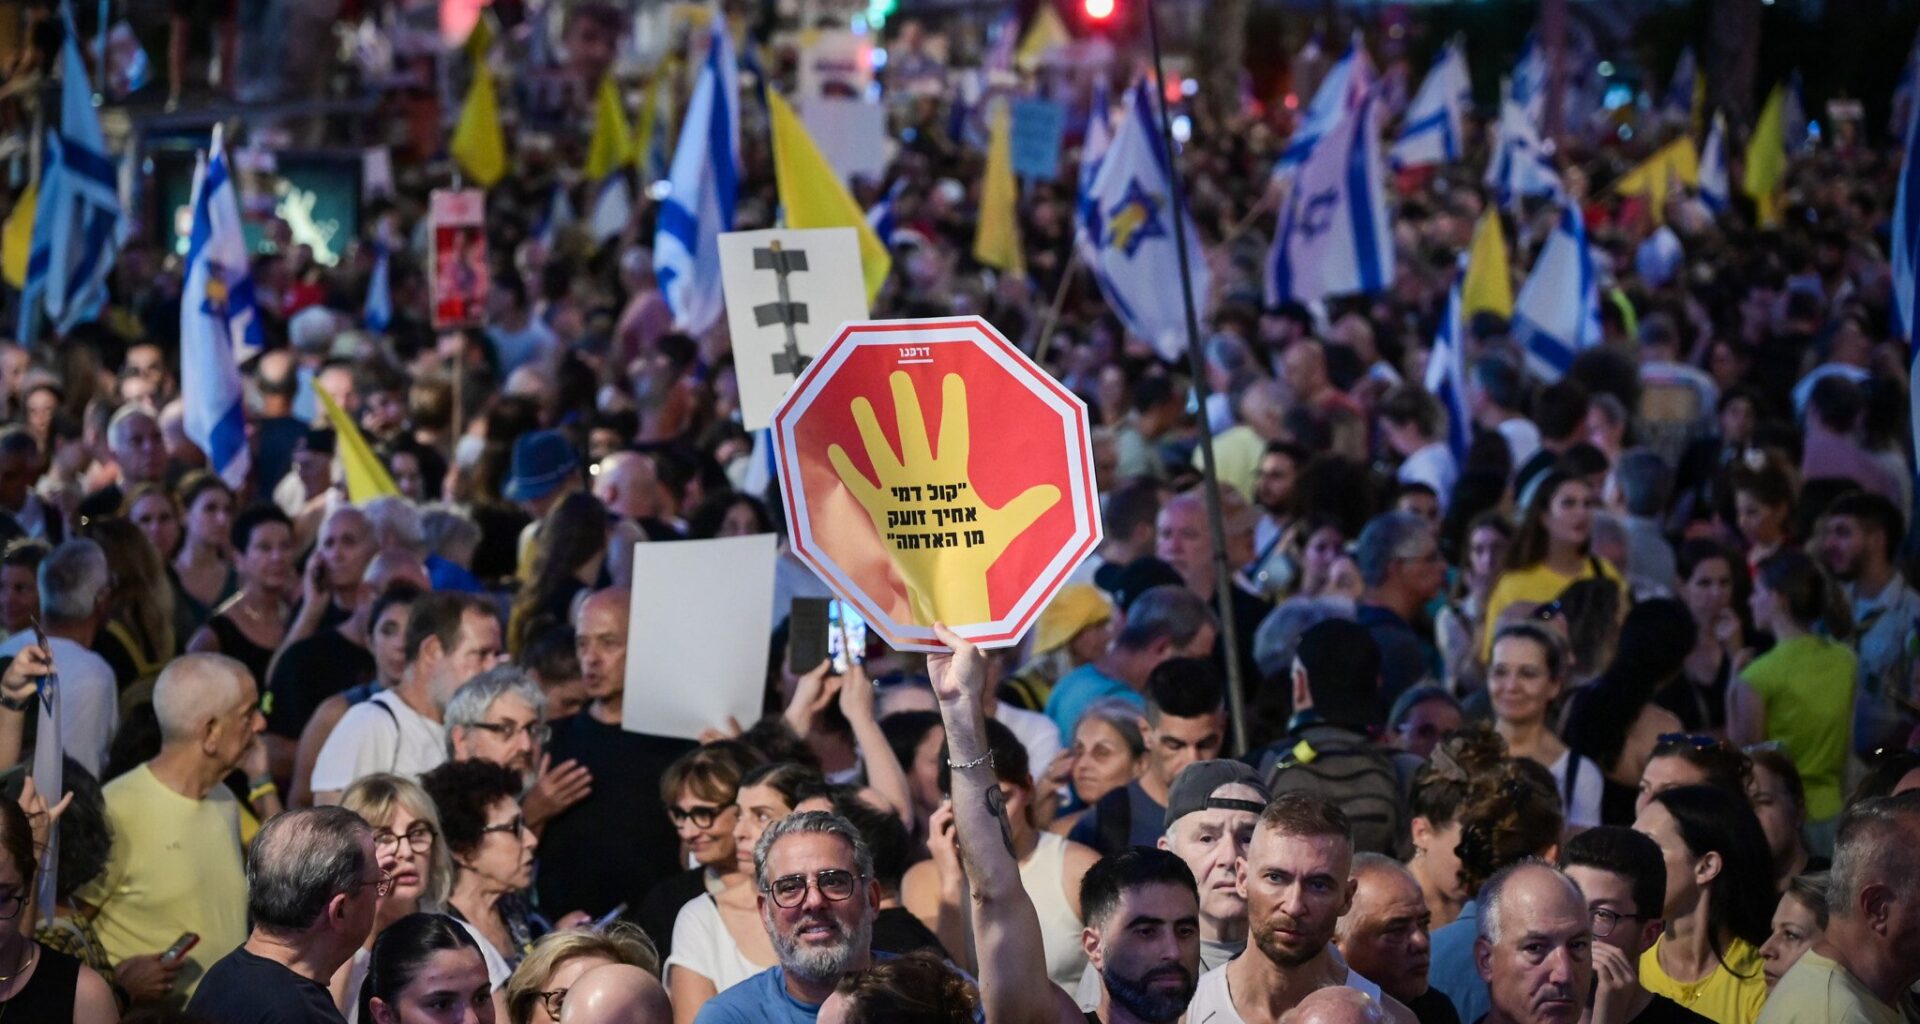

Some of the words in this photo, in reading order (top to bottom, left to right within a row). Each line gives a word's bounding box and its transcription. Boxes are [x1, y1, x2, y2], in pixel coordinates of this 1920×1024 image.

[891, 486, 922, 502] דמי
[888, 510, 926, 528] זועק
[932, 507, 977, 527] אחיך
[964, 530, 985, 548] מן
